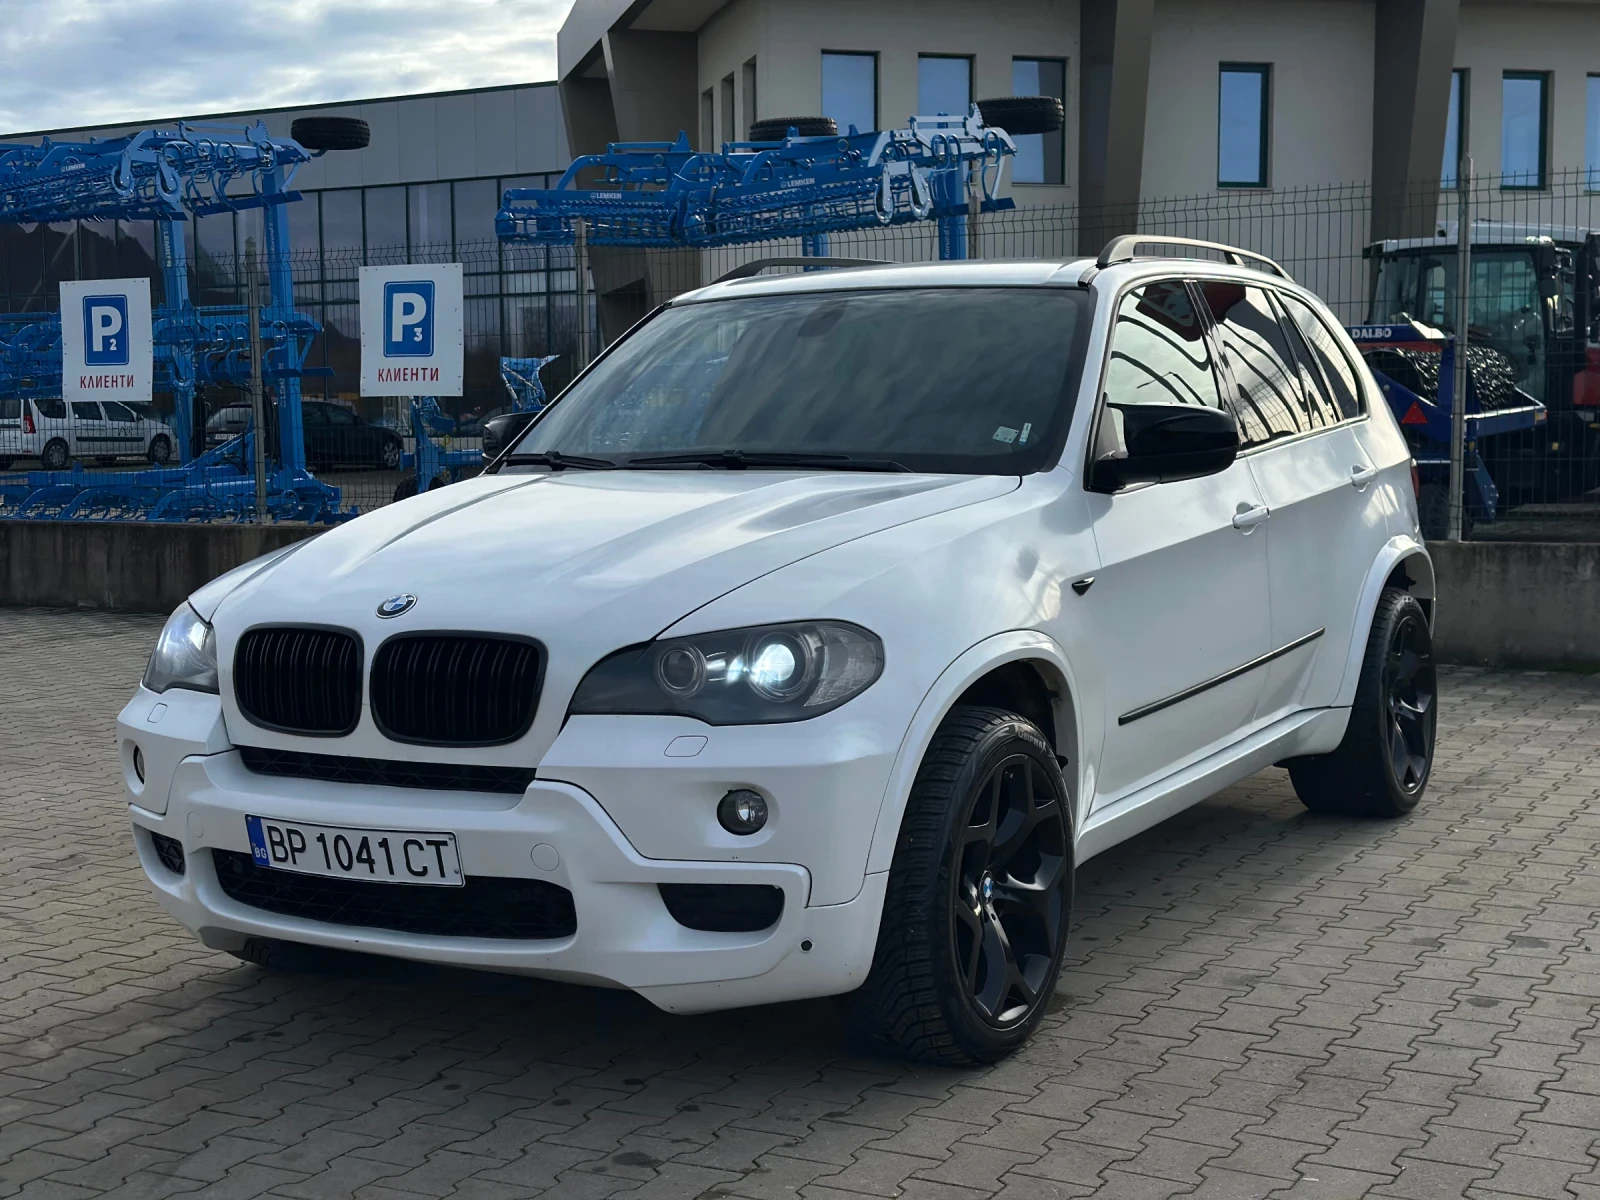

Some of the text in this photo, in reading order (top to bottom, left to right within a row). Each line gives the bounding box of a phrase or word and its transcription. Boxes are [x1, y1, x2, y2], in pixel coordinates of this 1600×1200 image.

[787, 178, 815, 187] LEMKEN
[163, 231, 171, 267] LEMKEN
[1352, 328, 1392, 339] DALBO
[80, 375, 134, 389] КЛИЕНТИ
[378, 367, 439, 383] КЛИЕНТИ
[254, 847, 268, 859] BG
[266, 825, 449, 878] BP 1041 CT
